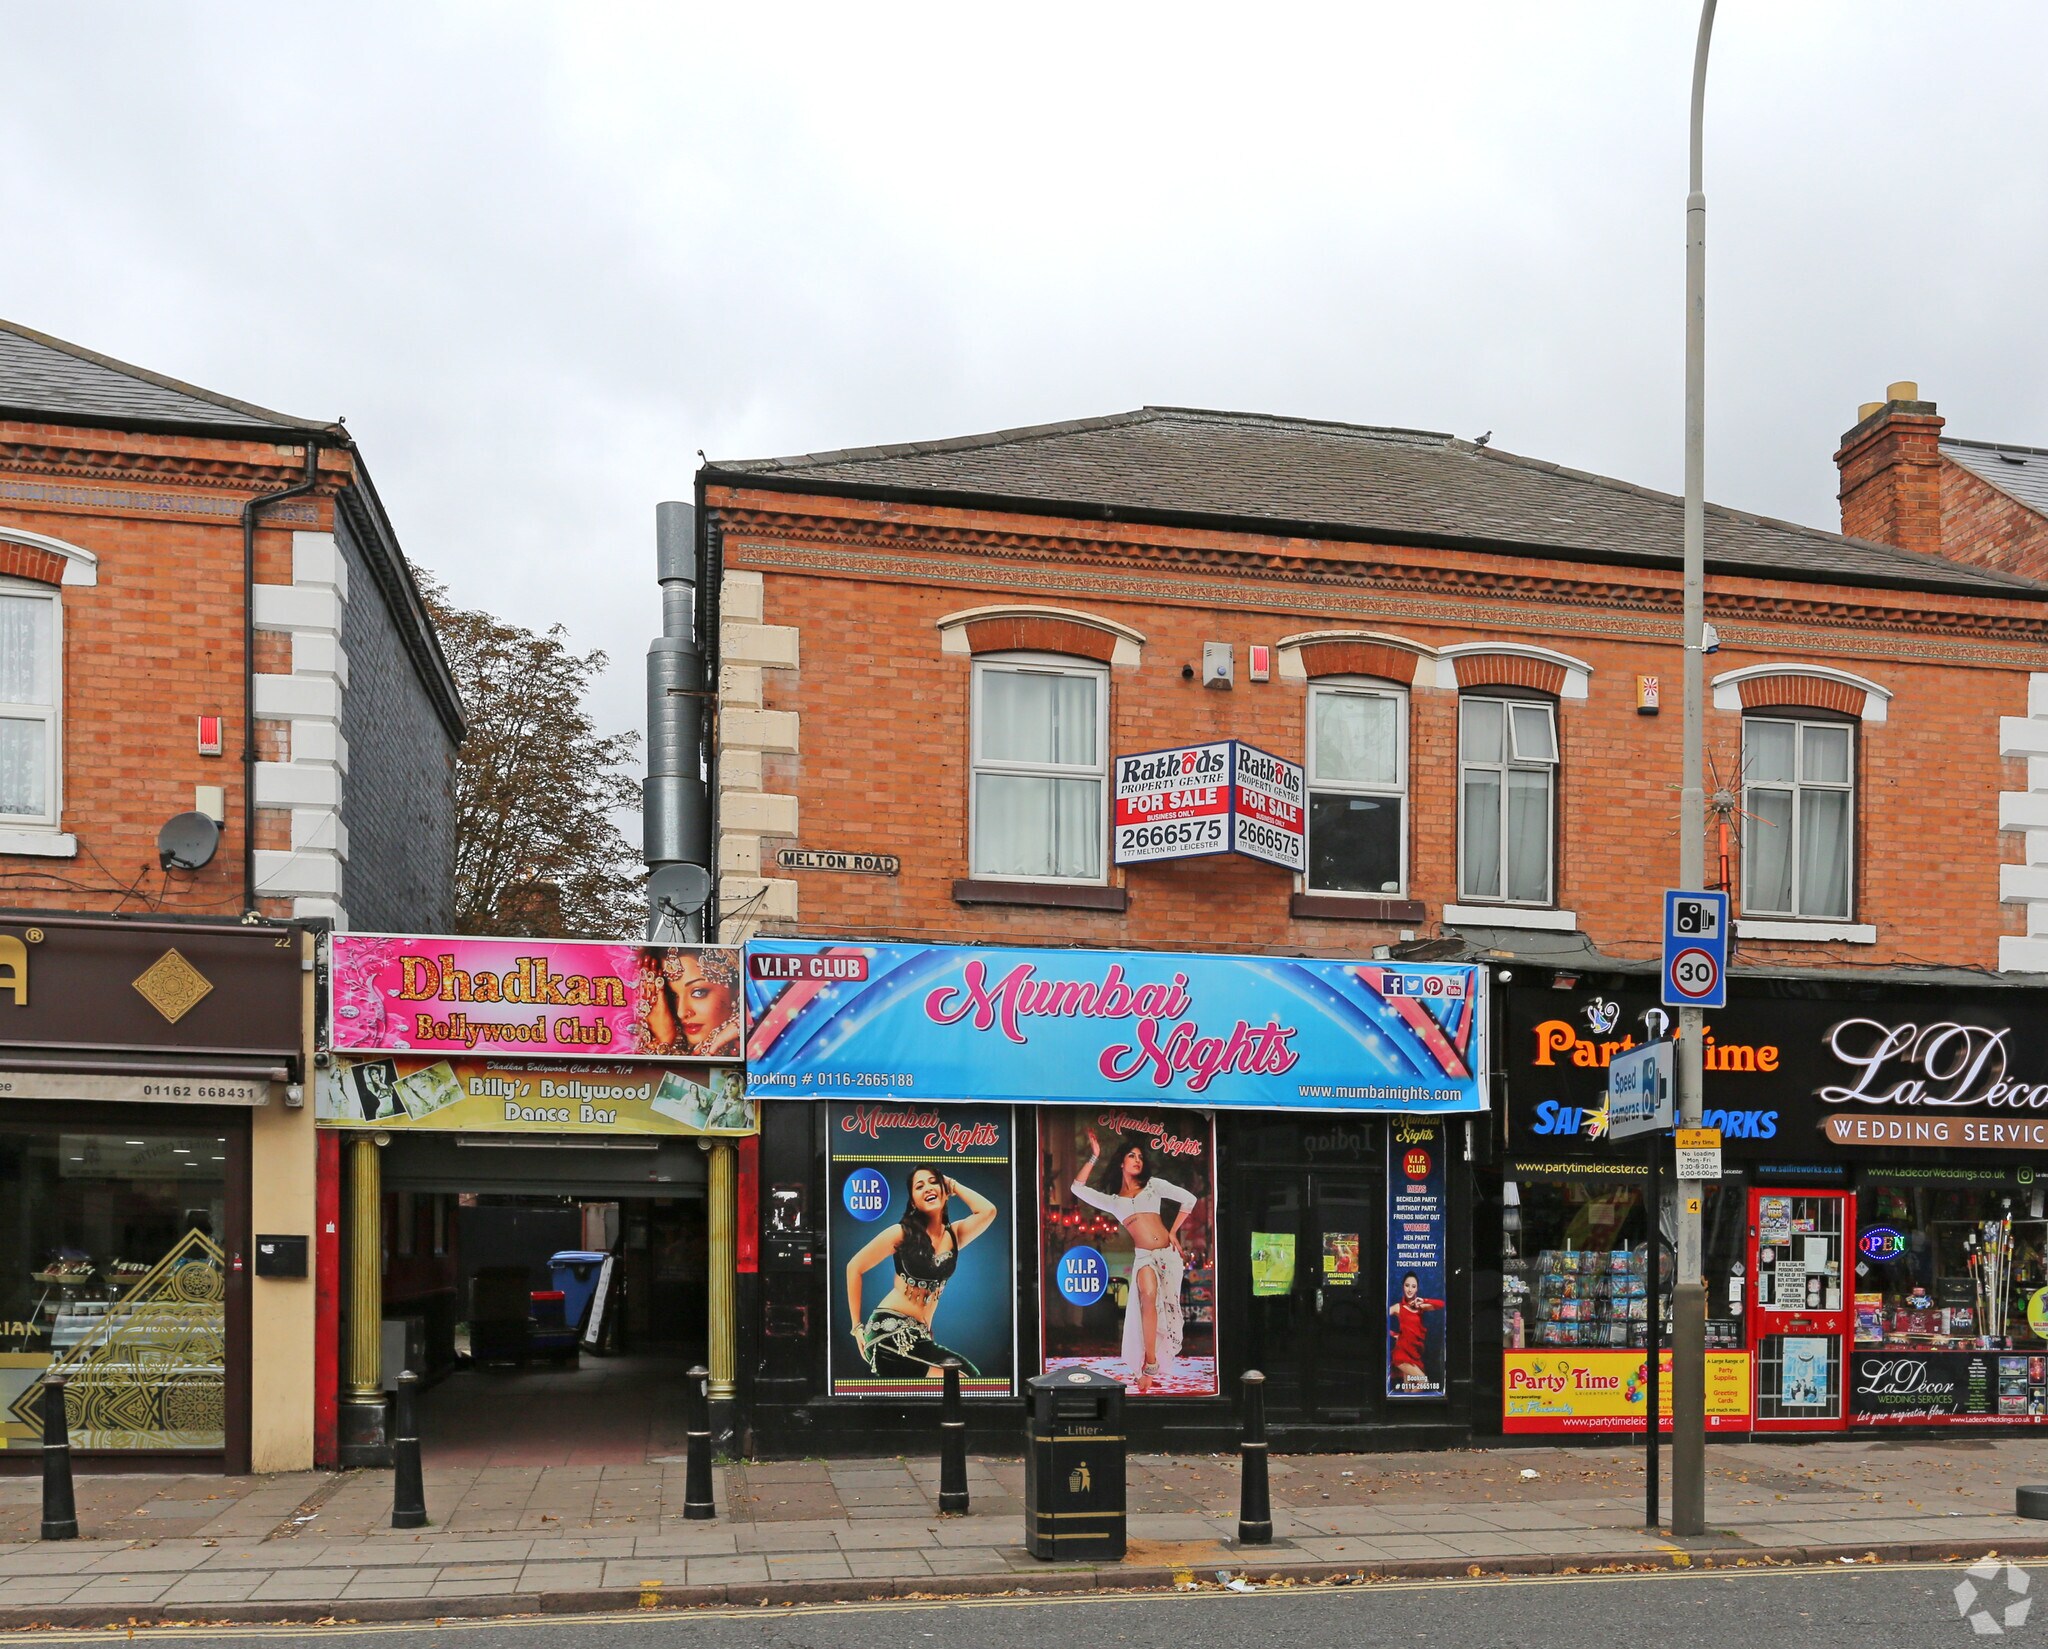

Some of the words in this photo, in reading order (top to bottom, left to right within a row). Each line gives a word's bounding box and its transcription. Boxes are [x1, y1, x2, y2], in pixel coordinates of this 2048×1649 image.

[1122, 750, 1224, 784] Rathods
[1238, 748, 1300, 792] Rathods
[1121, 779, 1176, 794] PROPERTY
[1237, 772, 1272, 793] PROPERTY
[1127, 794, 1164, 815] FOR
[1169, 787, 1218, 809] SALE
[1242, 788, 1266, 812] FOR
[1268, 798, 1297, 823] SALE
[1146, 811, 1177, 822] BUSINESS
[1178, 809, 1195, 817] ONLY
[1122, 819, 1222, 850] 2666575
[1238, 820, 1299, 857] 2666575
[1136, 846, 1165, 856] MELTON
[1180, 841, 1219, 851] LEICESTER
[783, 852, 846, 869] MELTON
[854, 856, 894, 872] ROAD
[1275, 851, 1298, 864] LEICESTER
[757, 957, 803, 977] V.I.P.
[809, 958, 860, 978] CLUB
[1680, 962, 1710, 982] 30
[399, 954, 628, 1007] Dhadkan
[1448, 978, 1460, 986] You
[1447, 986, 1461, 996] Tube
[924, 960, 1192, 1044] Mumbai
[415, 1013, 548, 1048] Bollywood
[554, 1017, 612, 1045] Club
[1098, 1018, 1300, 1092] Nights
[1819, 1018, 1927, 1104] La
[487, 1061, 524, 1071] Dhadkan
[527, 1063, 568, 1073] Bollywood
[569, 1064, 590, 1074] Club
[591, 1065, 610, 1075] Ltd.
[747, 1072, 797, 1087] Booking
[801, 1073, 813, 1085] #
[817, 1072, 914, 1087] 0116-2665188
[1615, 1066, 1636, 1098] Speed
[143, 1085, 191, 1097] 01162
[198, 1086, 254, 1098] 668431
[469, 1077, 531, 1101] Billy's
[540, 1079, 651, 1103] Bollywood
[1298, 1084, 1462, 1103] www.mumbainights.com
[505, 1102, 570, 1122] Dance
[579, 1103, 617, 1123] Bar
[1392, 1113, 1440, 1129] Mumbai
[1533, 1100, 1583, 1136] SAI
[1611, 1101, 1640, 1126] cameras
[841, 1104, 940, 1139] Mumbai
[1098, 1109, 1164, 1135] Mumbai
[923, 1122, 999, 1154] Nights
[1395, 1128, 1434, 1144] Nights
[1833, 1120, 1949, 1141] WEDDING
[1151, 1133, 1203, 1157] Nights
[1408, 1155, 1426, 1164] V.I.P.
[1407, 1164, 1427, 1174] CLUB
[1759, 1164, 1843, 1174] www.saifireworks.co.uk
[1868, 1167, 2005, 1180] www.LadecorWeddings.co.uk
[851, 1179, 881, 1194] V.I.P.
[1406, 1185, 1427, 1193] MENS
[850, 1195, 883, 1210] CLUB
[1690, 1201, 1698, 1211] 4
[1403, 1223, 1430, 1232] WOMEN
[1859, 1236, 1904, 1252] OPEN
[1066, 1258, 1098, 1274] V.I.P.
[1064, 1277, 1100, 1293] CLUB
[1508, 1368, 1565, 1393] Party
[1571, 1368, 1619, 1389] Time
[1857, 1360, 1897, 1394] La
[1713, 1389, 1738, 1397] Greeting
[1878, 1395, 1915, 1404] WEDDING
[1917, 1395, 1953, 1404] SERVICES
[1857, 1410, 1869, 1423] Let
[1870, 1413, 1888, 1425] your
[1890, 1409, 1927, 1421] imagination
[1949, 1416, 2031, 1425] www.LadecorWeddings.co.uk
[1067, 1425, 1099, 1436] Litter
